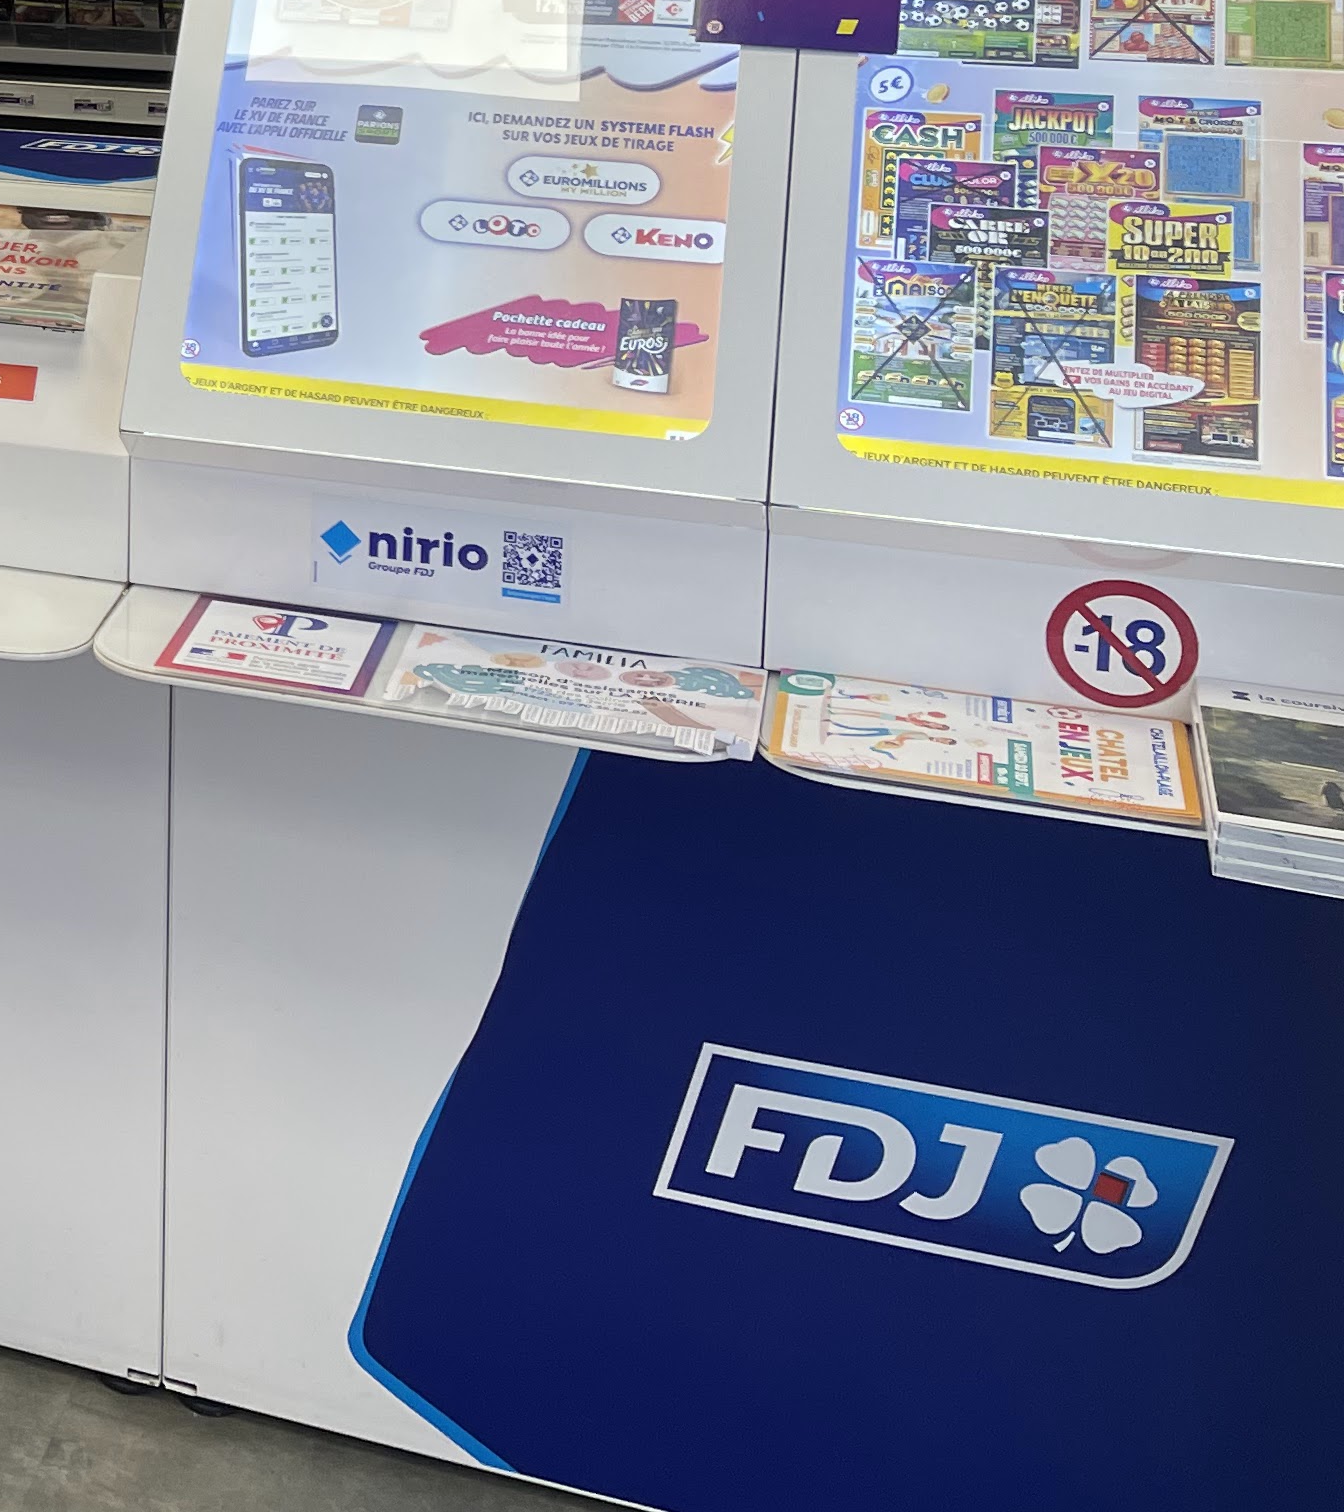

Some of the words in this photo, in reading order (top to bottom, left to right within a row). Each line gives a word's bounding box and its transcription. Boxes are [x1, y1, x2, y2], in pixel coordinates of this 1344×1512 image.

[468, 112, 489, 124] ICI,
[493, 114, 571, 129] DEMANDEZ
[574, 119, 594, 131] UN
[600, 120, 665, 135] SYSTEME
[669, 124, 715, 138] FLASH
[1008, 105, 1098, 136] JACKPOT
[502, 130, 529, 141] SUR
[533, 132, 562, 144] VOS
[564, 134, 598, 147] JEUX
[601, 137, 620, 148] DE
[623, 138, 674, 152] TIRAGE
[871, 124, 964, 150] CASH
[543, 175, 648, 192] EUROMILLIONS
[473, 214, 541, 235] LOTO
[1123, 217, 1220, 251] SUPER
[635, 228, 714, 249] KENO
[368, 526, 489, 573] nirio
[213, 629, 300, 650] PAIEMENT
[316, 643, 346, 654] DE
[540, 643, 649, 670] FAMILIA
[705, 1083, 1004, 1221] FDJ
